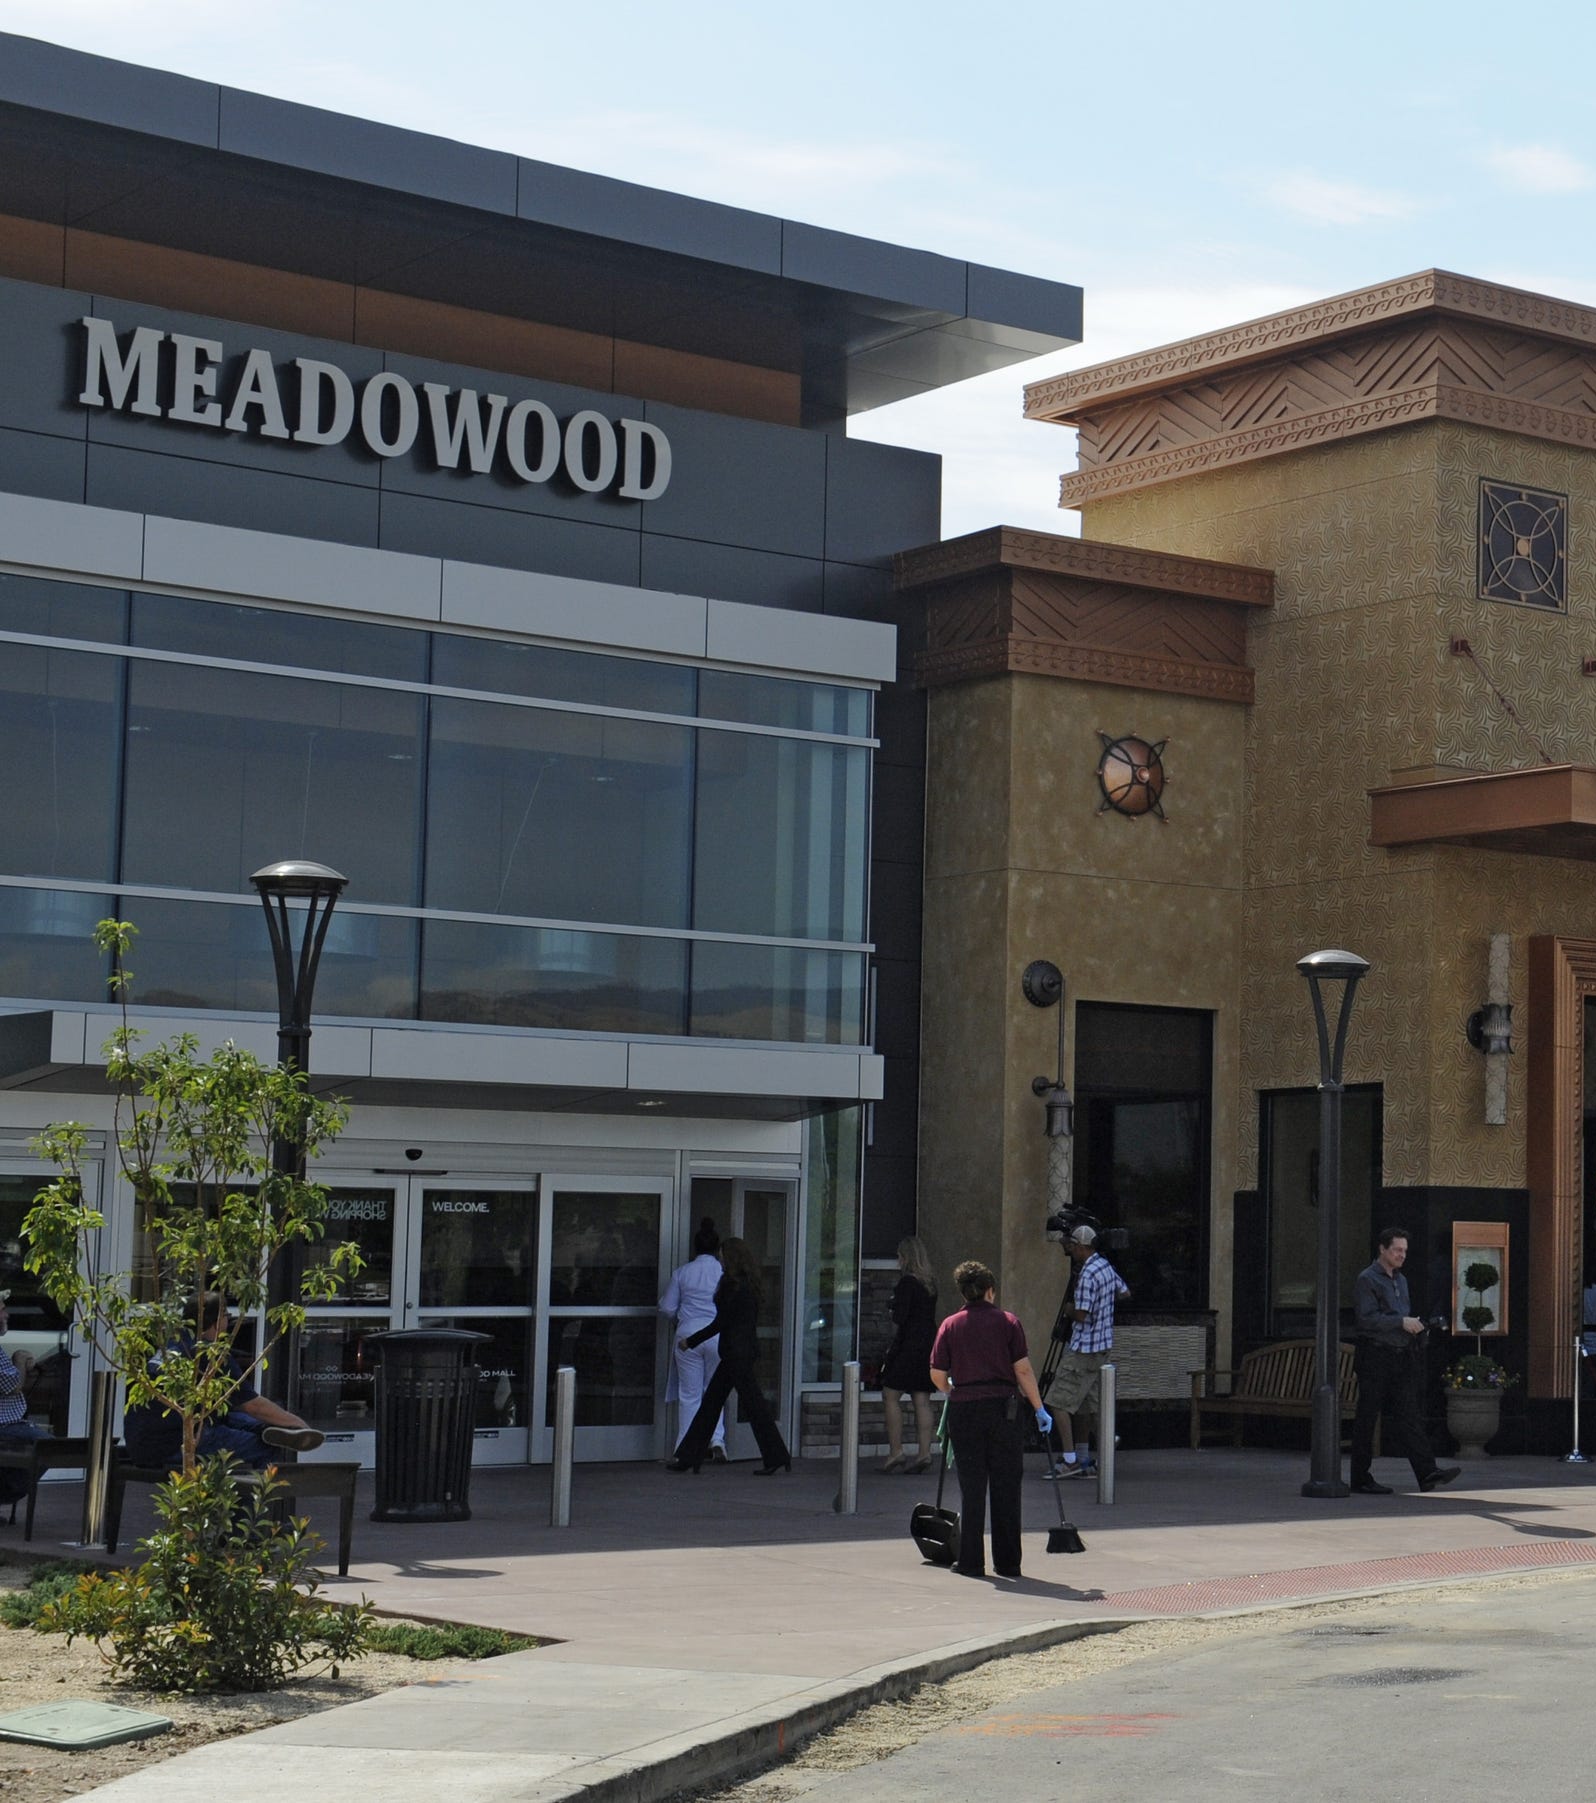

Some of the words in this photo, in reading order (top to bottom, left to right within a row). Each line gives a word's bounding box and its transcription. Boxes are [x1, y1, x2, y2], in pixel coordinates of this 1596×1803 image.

[79, 316, 673, 501] MEADOWOOD
[431, 1200, 490, 1213] WELCOME.
[491, 1369, 516, 1377] MALL
